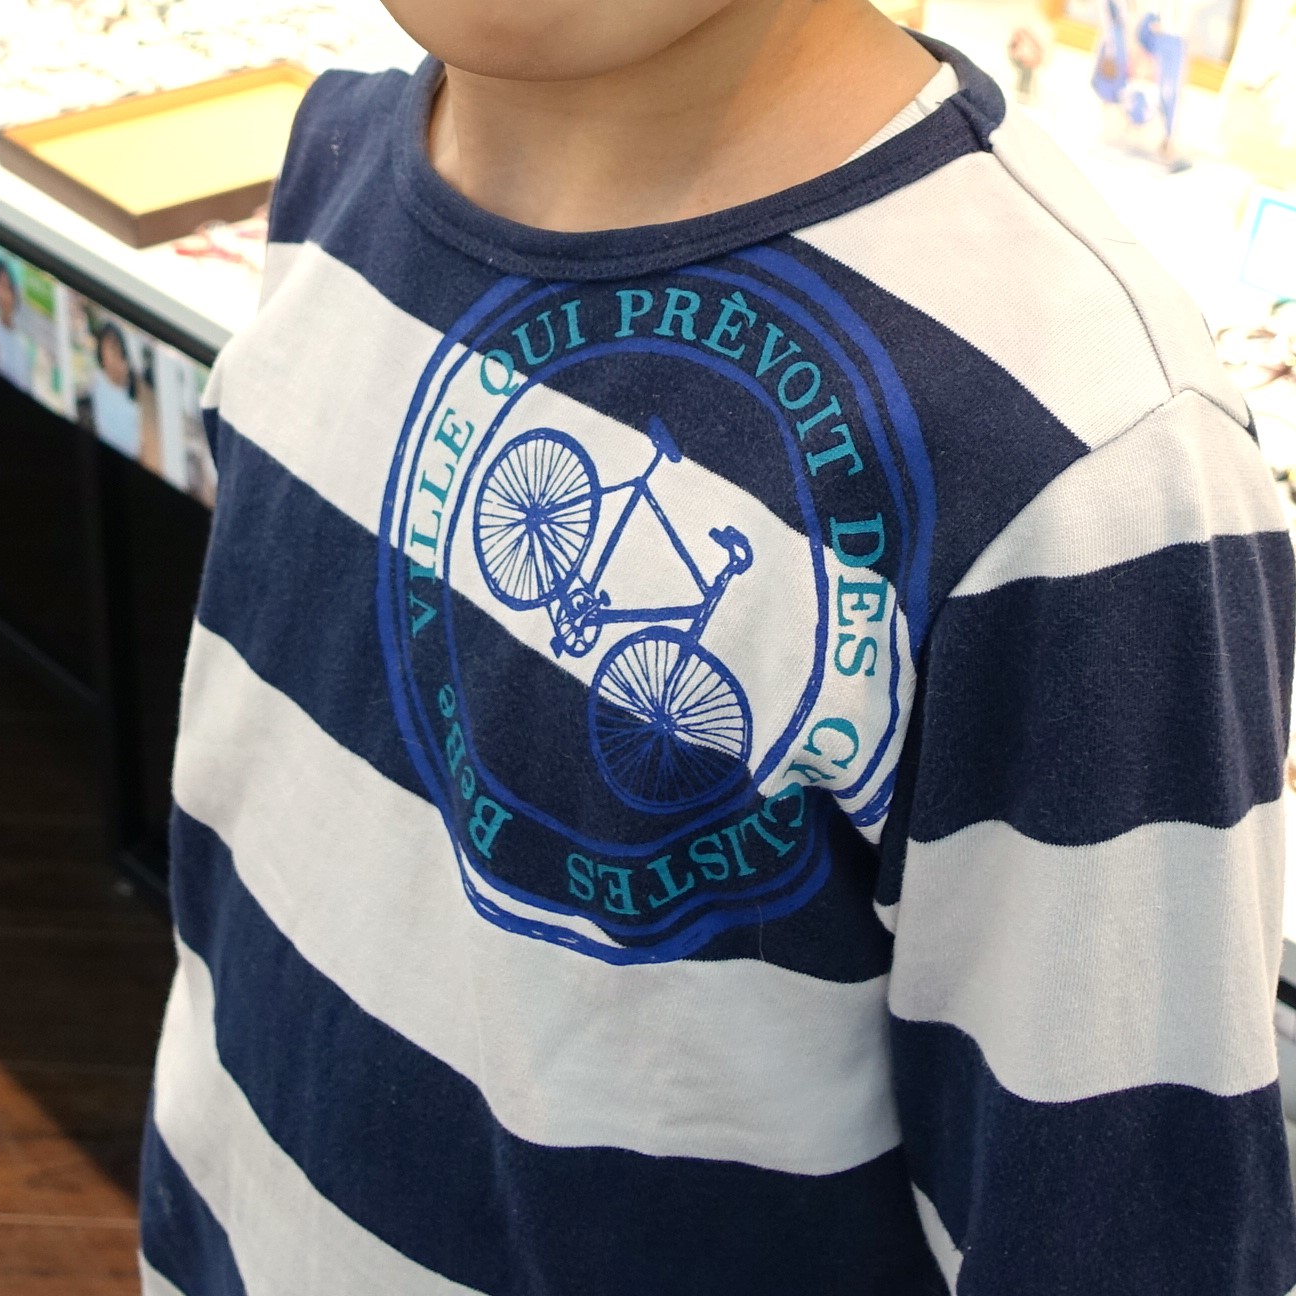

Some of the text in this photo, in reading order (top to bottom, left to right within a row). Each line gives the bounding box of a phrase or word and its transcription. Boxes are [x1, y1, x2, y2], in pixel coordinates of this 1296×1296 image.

[406, 406, 476, 637] VILLE
[478, 299, 588, 400] QUI
[828, 511, 890, 679] DES
